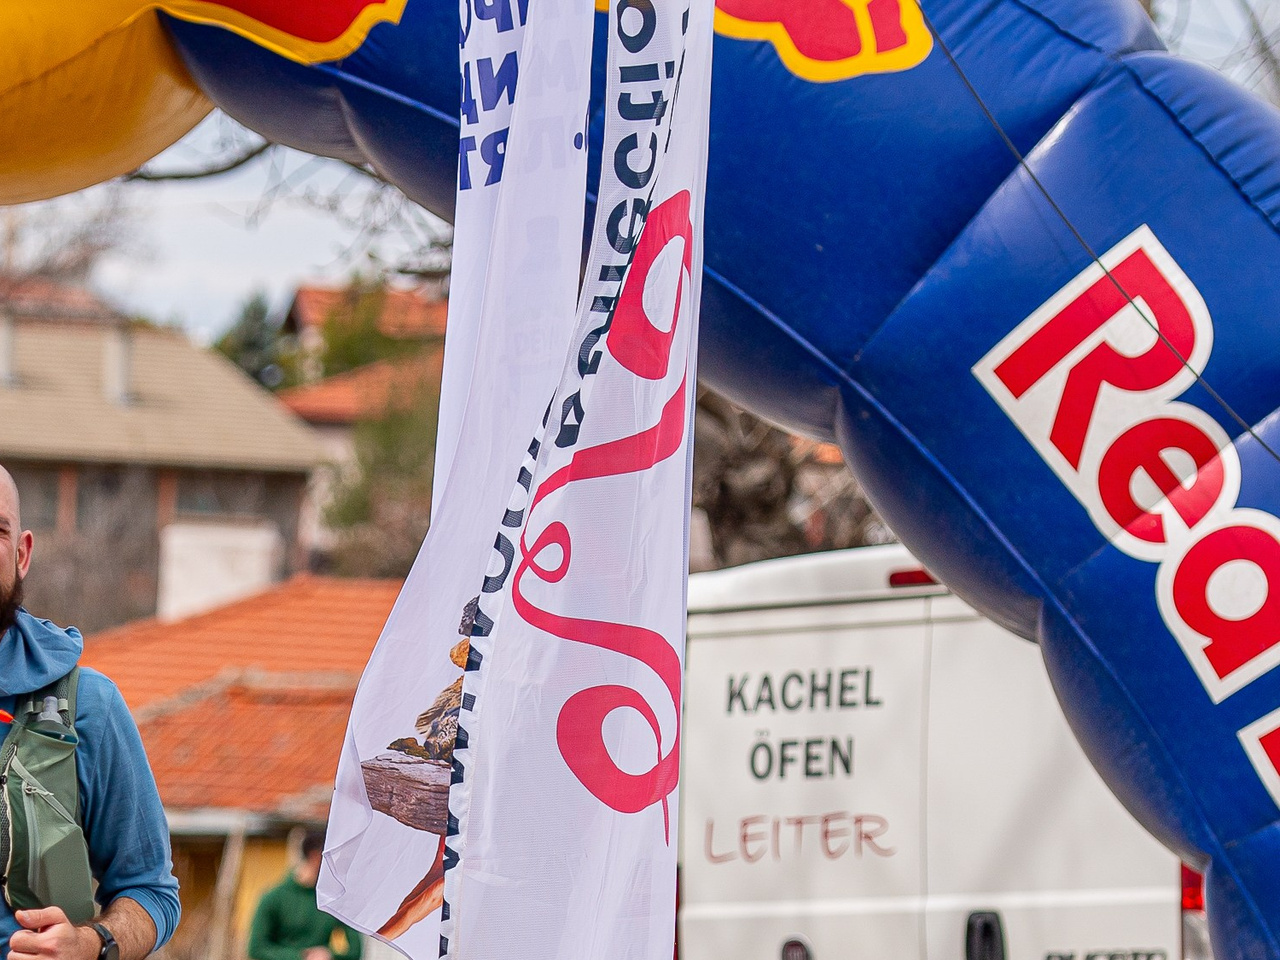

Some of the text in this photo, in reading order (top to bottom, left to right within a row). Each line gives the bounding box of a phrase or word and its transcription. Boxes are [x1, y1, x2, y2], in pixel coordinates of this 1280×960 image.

[726, 668, 883, 712] KACHEL
[748, 730, 854, 780] ÖFEN
[704, 810, 898, 864] LEITER
